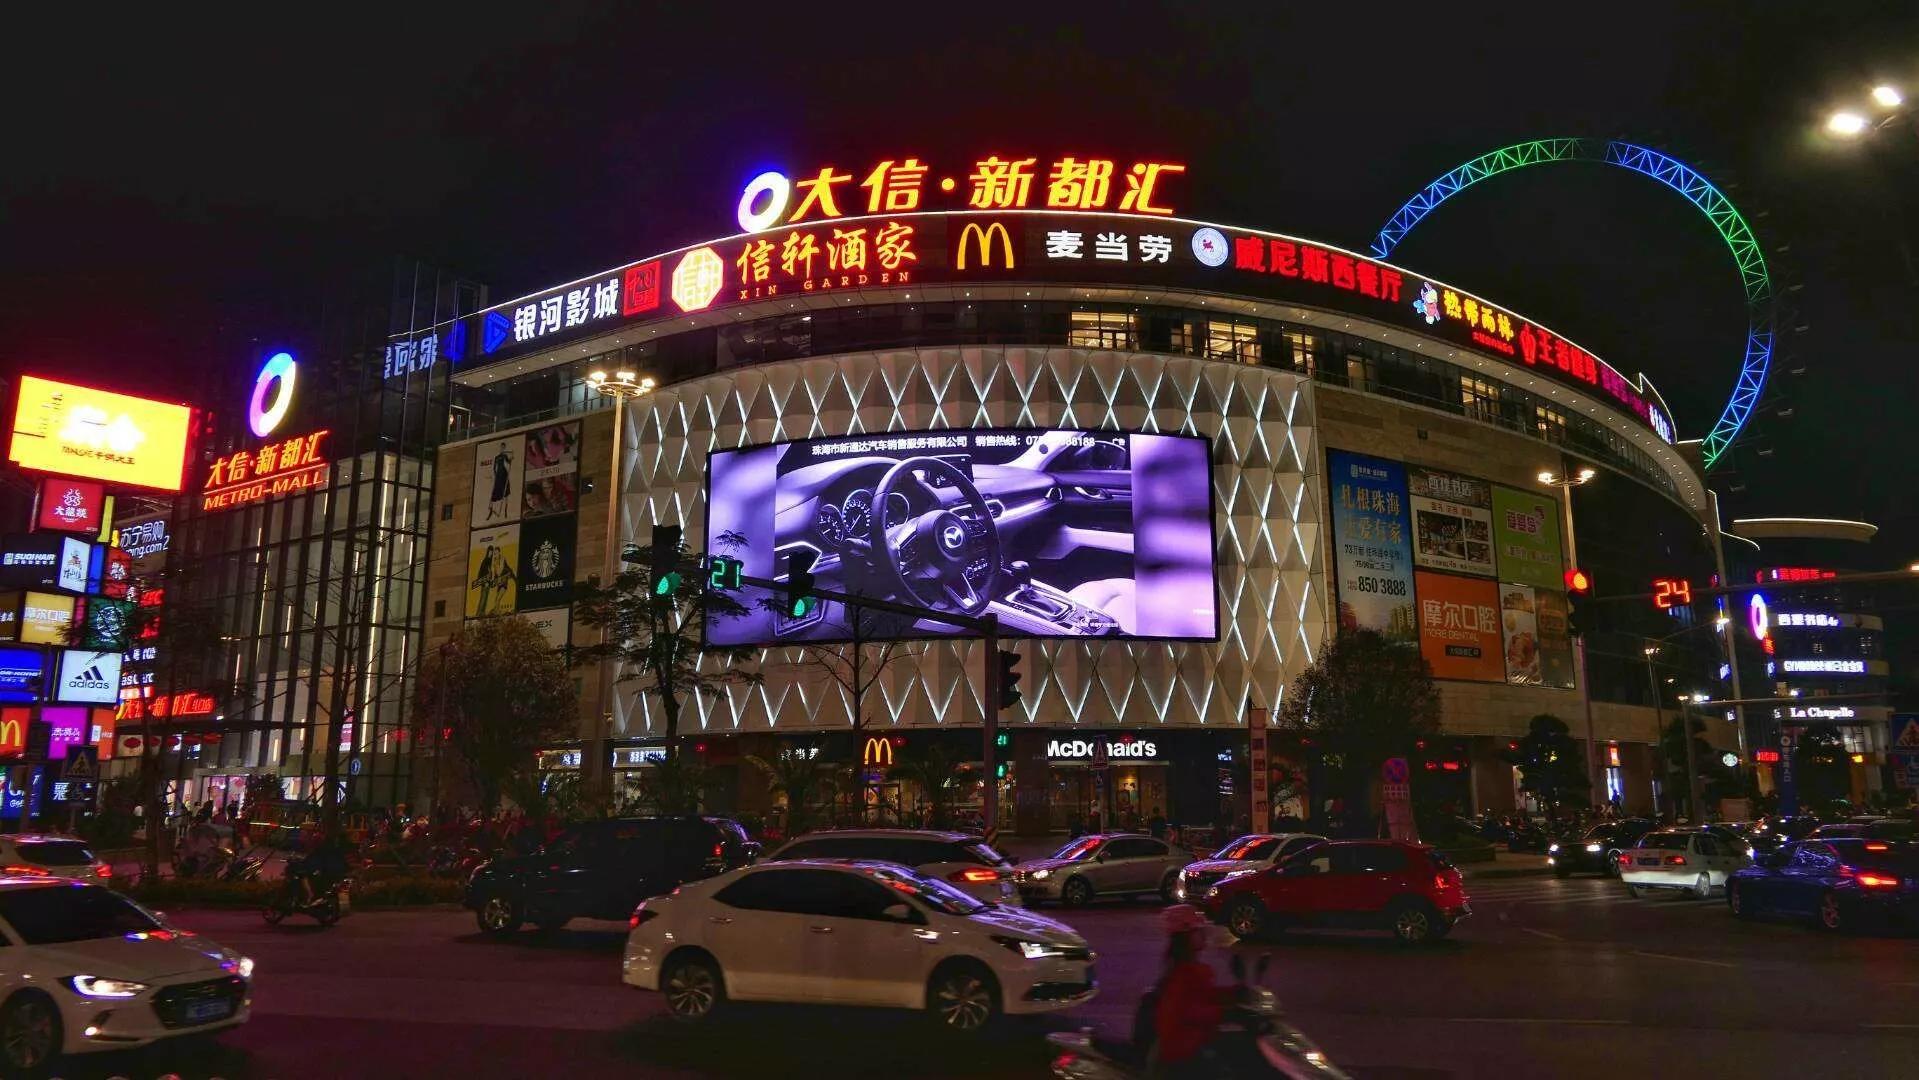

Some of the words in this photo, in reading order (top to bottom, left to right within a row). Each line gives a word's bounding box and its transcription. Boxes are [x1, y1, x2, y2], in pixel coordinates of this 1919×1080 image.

[789, 156, 1185, 222] 大信·新都汇
[737, 222, 917, 285] 信轩酒家
[1046, 230, 1172, 263] 麦当劳
[1235, 236, 1402, 302] 威尼斯西餐厅
[740, 284, 777, 300] XIN
[804, 271, 911, 290] GARDEN
[514, 278, 619, 342] 银河影城
[204, 430, 328, 488] 大信·新都汇
[204, 471, 323, 510] METRO-MALL
[120, 521, 164, 548] 苏宁易购
[525, 580, 564, 591] STARBUCKS
[712, 560, 742, 589] 21
[1358, 576, 1378, 593] 850
[1380, 578, 1406, 596] 3888
[1655, 580, 1691, 608] 24
[1423, 599, 1496, 634] 摩尔口腔
[69, 680, 110, 689] adidas
[1790, 708, 1806, 718] La
[1807, 706, 1855, 719] Chapelle
